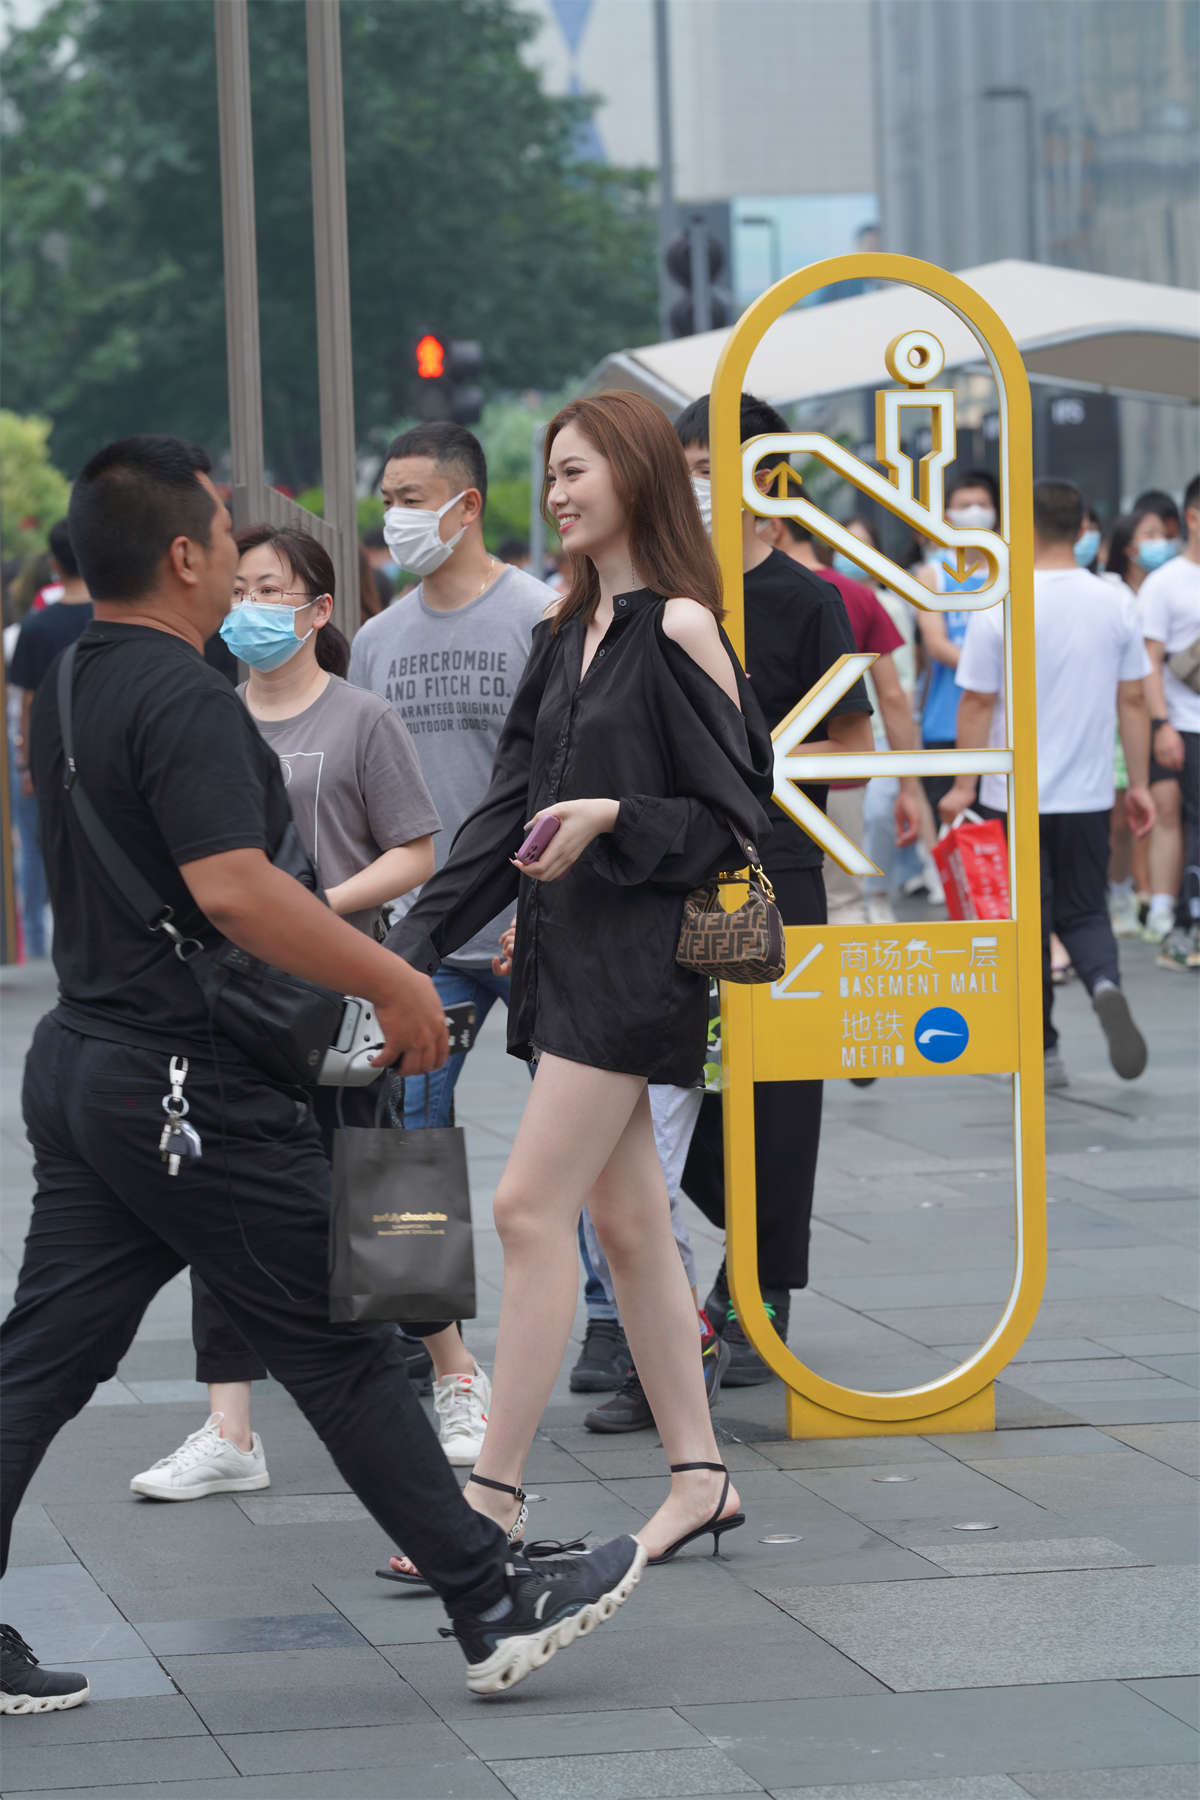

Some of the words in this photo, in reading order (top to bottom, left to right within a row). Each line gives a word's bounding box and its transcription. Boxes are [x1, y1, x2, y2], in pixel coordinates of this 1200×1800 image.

[388, 651, 508, 678] ABERCROMBIE
[385, 680, 416, 701] AND
[425, 675, 470, 698] FITCH
[479, 676, 511, 698] CO.
[399, 702, 454, 719] ARANTEED
[456, 701, 506, 716] ORIGINAL
[839, 936, 1000, 972] 商场负一层
[839, 973, 941, 998] BASEMENT
[951, 972, 1000, 994] MALL
[840, 1008, 904, 1042] 地铁
[841, 1044, 905, 1068] METRO
